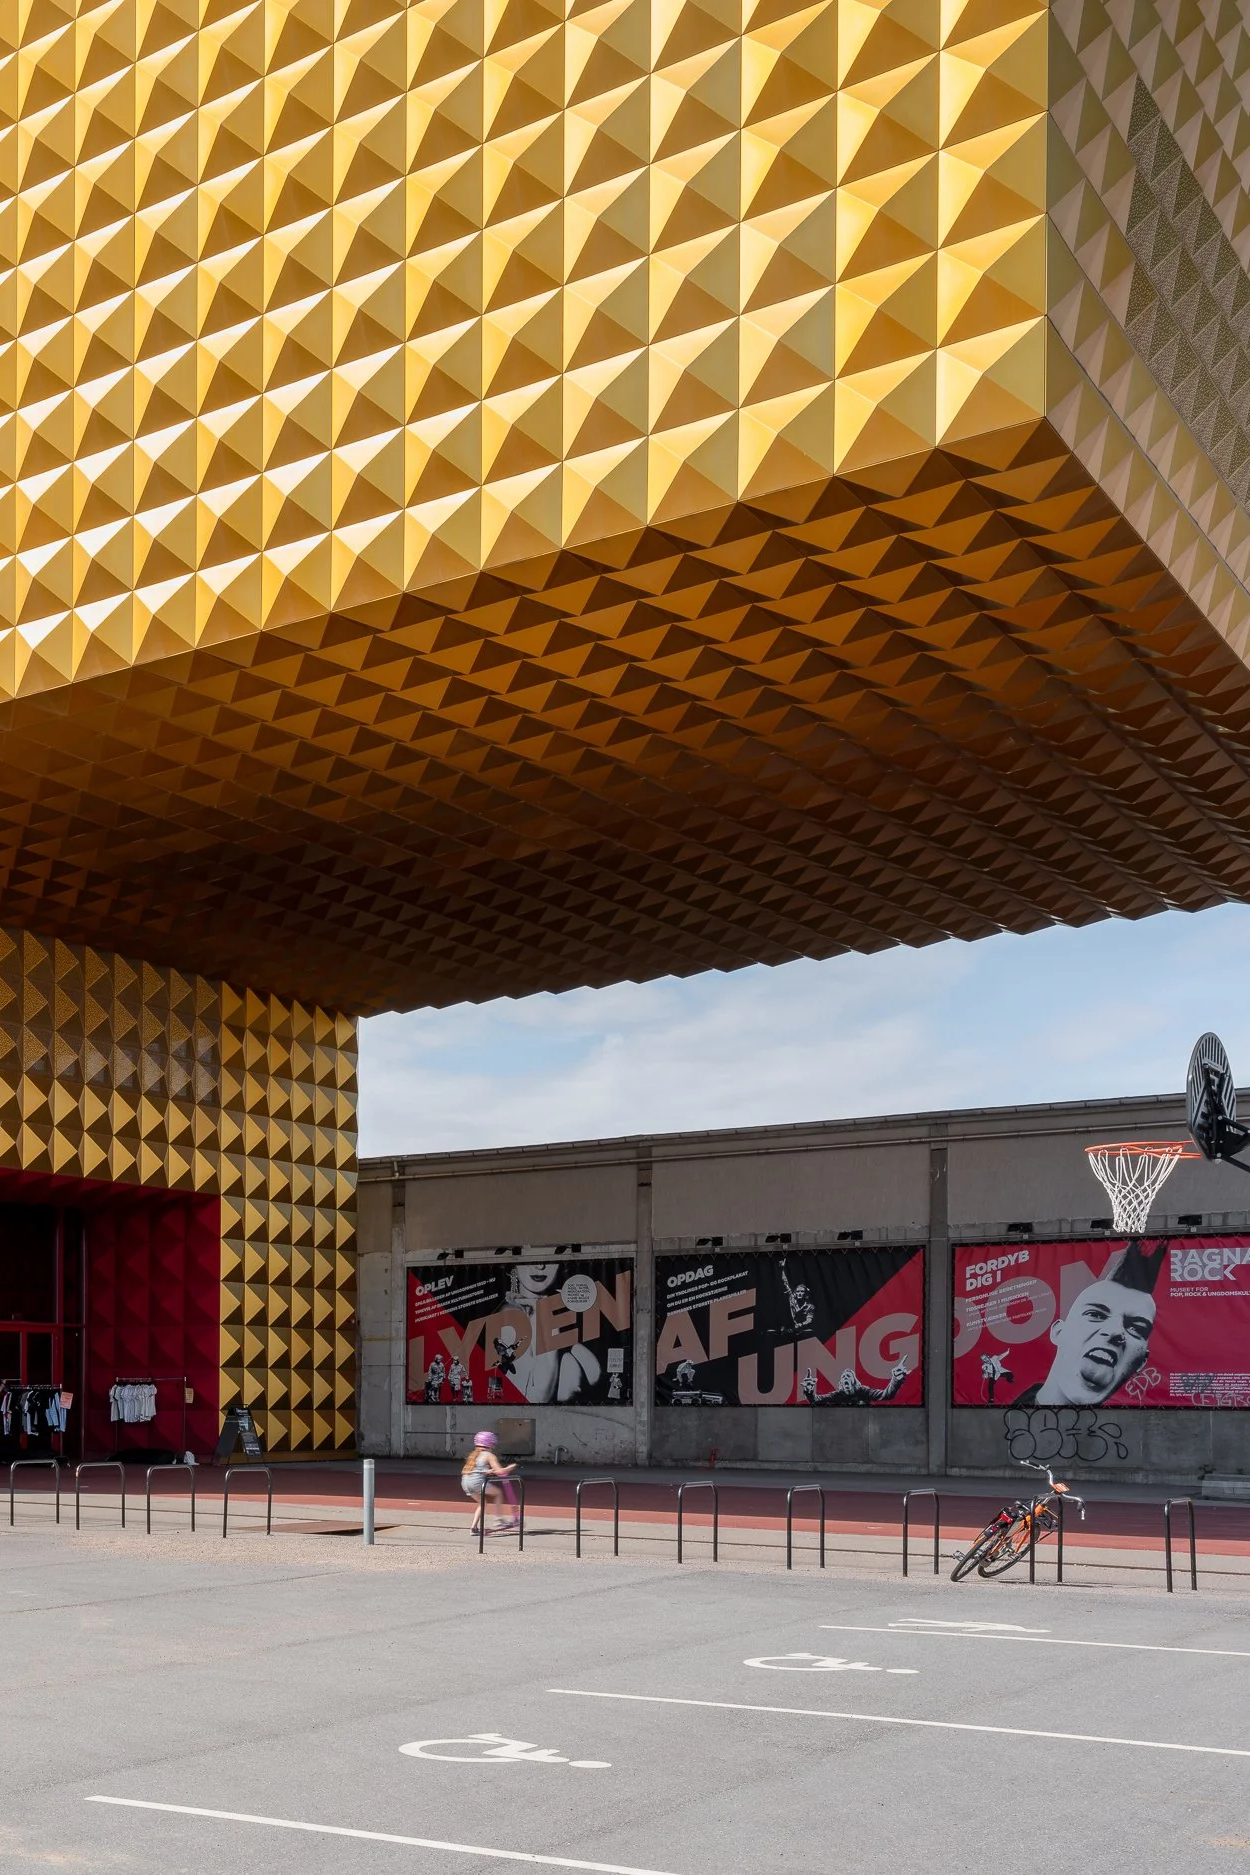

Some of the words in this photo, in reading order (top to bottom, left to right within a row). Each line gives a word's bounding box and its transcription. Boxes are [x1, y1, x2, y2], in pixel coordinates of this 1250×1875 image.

[966, 1250, 1029, 1278] FORDYB
[1171, 1264, 1237, 1281] ROCK
[415, 1275, 454, 1297] OPLEV
[667, 1265, 714, 1288] OPDAG
[718, 1270, 748, 1284] ROCKPLAKAT
[966, 1273, 992, 1291] DIG
[996, 1270, 1002, 1283] I
[409, 1270, 630, 1392] LYDEN
[657, 1287, 756, 1375] AF
[738, 1313, 919, 1405] UNG
